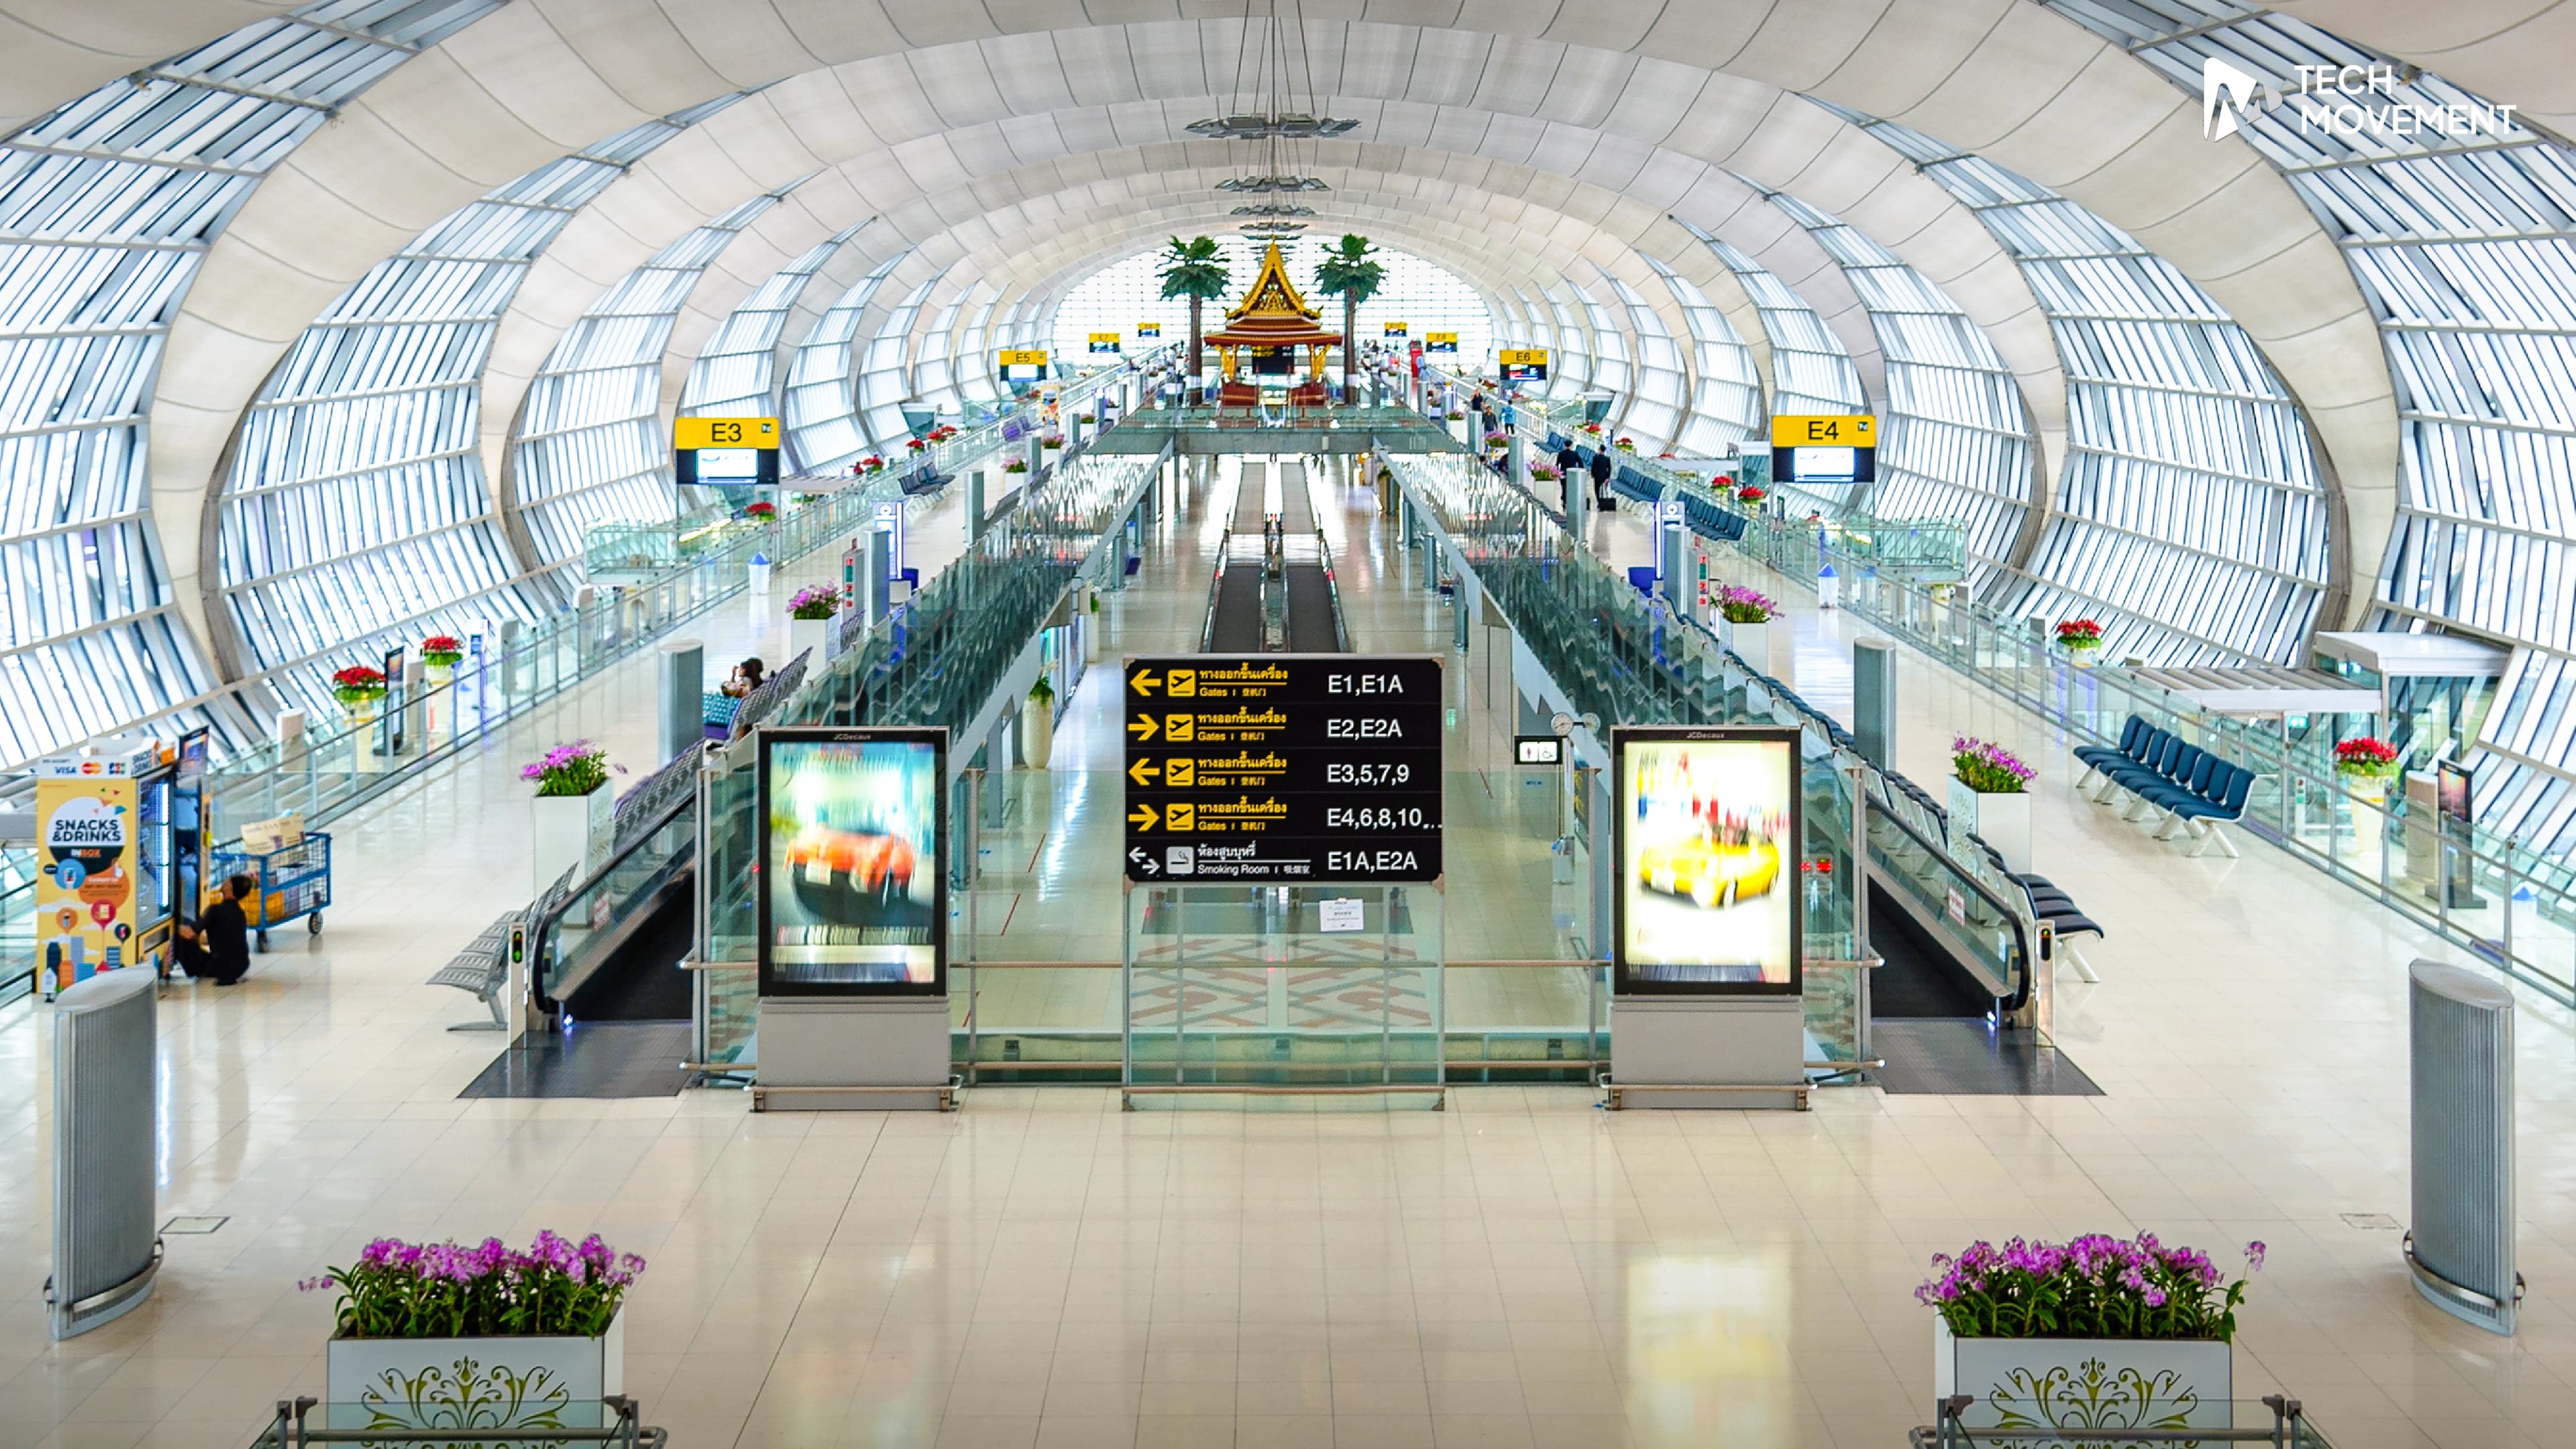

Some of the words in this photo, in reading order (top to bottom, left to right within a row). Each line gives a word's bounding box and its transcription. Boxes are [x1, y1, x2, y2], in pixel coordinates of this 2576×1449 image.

[1016, 353, 1030, 362] E5
[1516, 352, 1531, 362] E6
[712, 423, 742, 442] E3
[1808, 421, 1839, 440] E4
[1329, 674, 1403, 696] E1,E1A
[1199, 687, 1228, 697] Gates
[1328, 718, 1402, 741] E2,E2A
[1197, 731, 1226, 741] Gates
[54, 766, 76, 774] VISA
[1328, 763, 1409, 786] E3,5,7,9
[1197, 776, 1226, 786] Gates
[56, 819, 119, 830] SNACKS
[1197, 820, 1226, 830] Gates
[52, 830, 121, 842] &DRINKS
[1328, 851, 1417, 873] E1A,E2A
[1197, 864, 1238, 875] Smoking
[1241, 864, 1269, 873] Room
